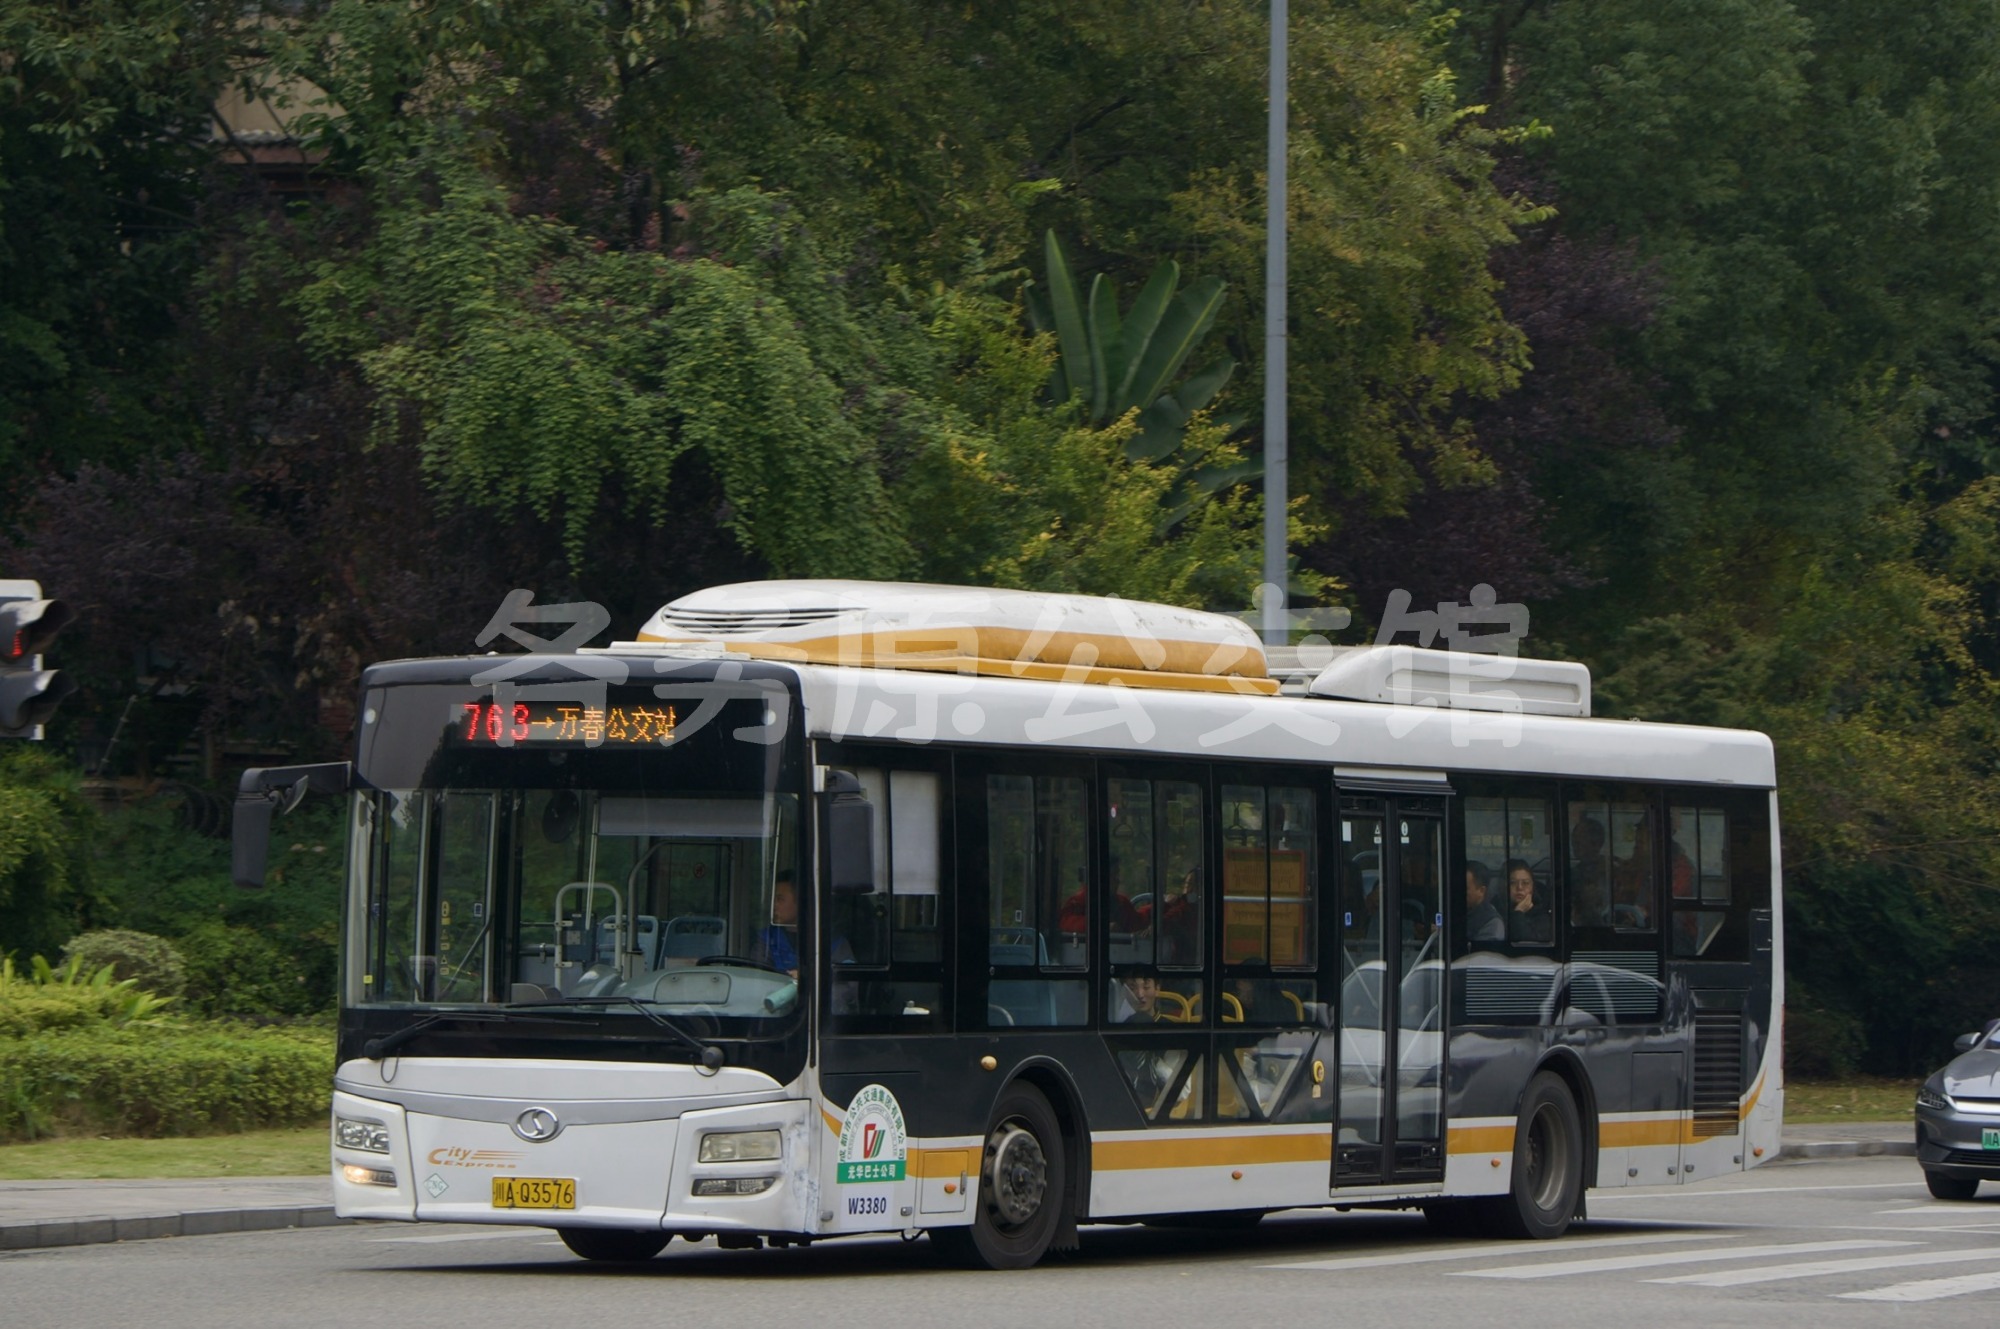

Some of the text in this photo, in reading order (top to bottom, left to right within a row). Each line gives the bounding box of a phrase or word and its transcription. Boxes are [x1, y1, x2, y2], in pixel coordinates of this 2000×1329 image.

[464, 703, 677, 743] 763 万春公交站
[428, 1146, 472, 1165] City
[442, 1160, 517, 1169] Express
[848, 1164, 896, 1180] 光华巴士公司
[848, 1196, 887, 1215] W3380
